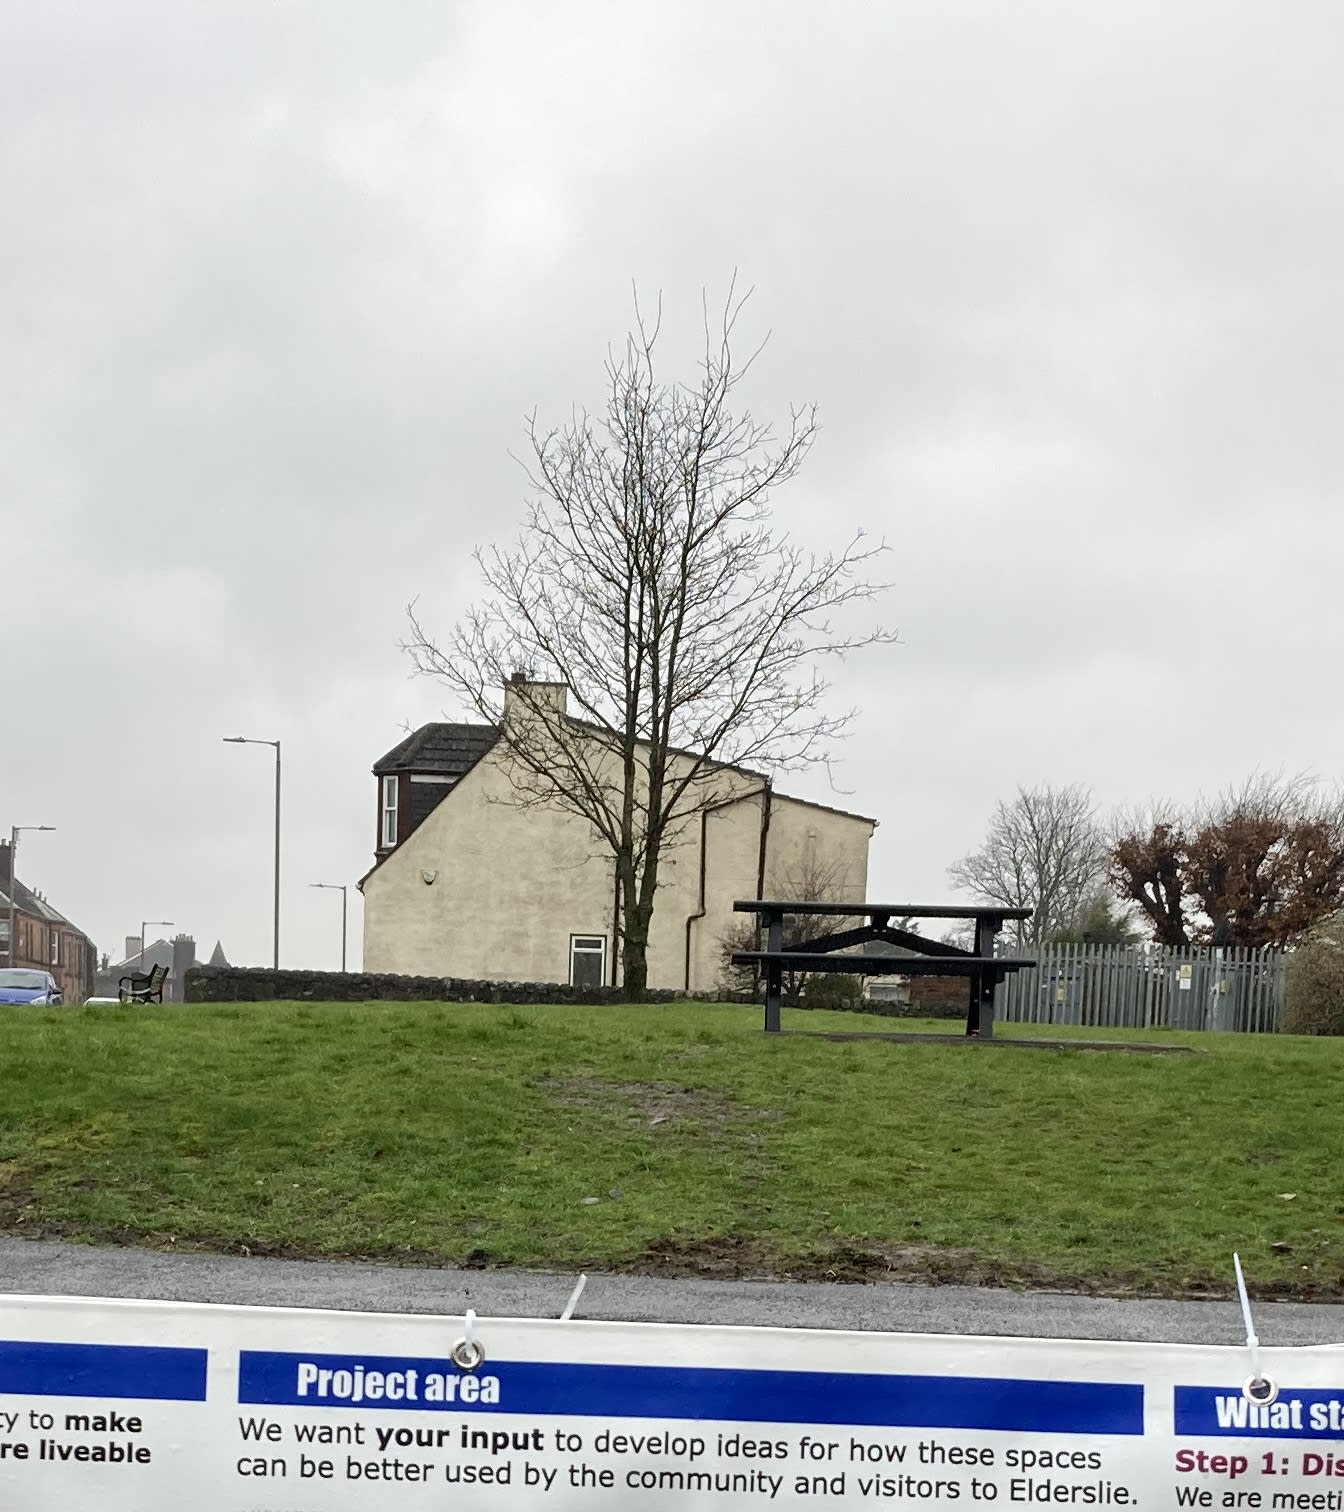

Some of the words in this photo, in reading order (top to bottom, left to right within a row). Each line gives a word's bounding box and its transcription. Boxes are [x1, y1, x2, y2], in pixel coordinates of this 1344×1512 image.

[296, 1362, 419, 1402] Project
[424, 1369, 500, 1404] area
[28, 1409, 55, 1431] to
[64, 1410, 143, 1433] make
[1214, 1396, 1304, 1430] What
[39, 1438, 152, 1464] liveable
[238, 1416, 283, 1442] We
[293, 1422, 366, 1445] want
[375, 1427, 451, 1452] your
[460, 1424, 545, 1456] input
[554, 1429, 583, 1453] to
[594, 1429, 706, 1462] develop
[717, 1433, 789, 1460] ideas
[799, 1436, 840, 1461] for
[849, 1437, 908, 1463] how
[917, 1439, 995, 1467] these
[1005, 1449, 1102, 1473] spaces
[236, 1457, 287, 1477] can
[300, 1453, 334, 1479] be
[346, 1455, 435, 1482] better
[445, 1460, 512, 1485] used
[524, 1461, 558, 1492] by
[568, 1463, 615, 1488] the
[625, 1469, 784, 1499] community
[794, 1471, 846, 1496] and
[857, 1473, 961, 1500] visitors
[970, 1477, 998, 1501] to
[1010, 1478, 1138, 1506] Elderslie.
[1175, 1449, 1249, 1480] Step
[1260, 1451, 1289, 1476] 1:
[1175, 1485, 1213, 1508] We
[1221, 1491, 1262, 1509] are
